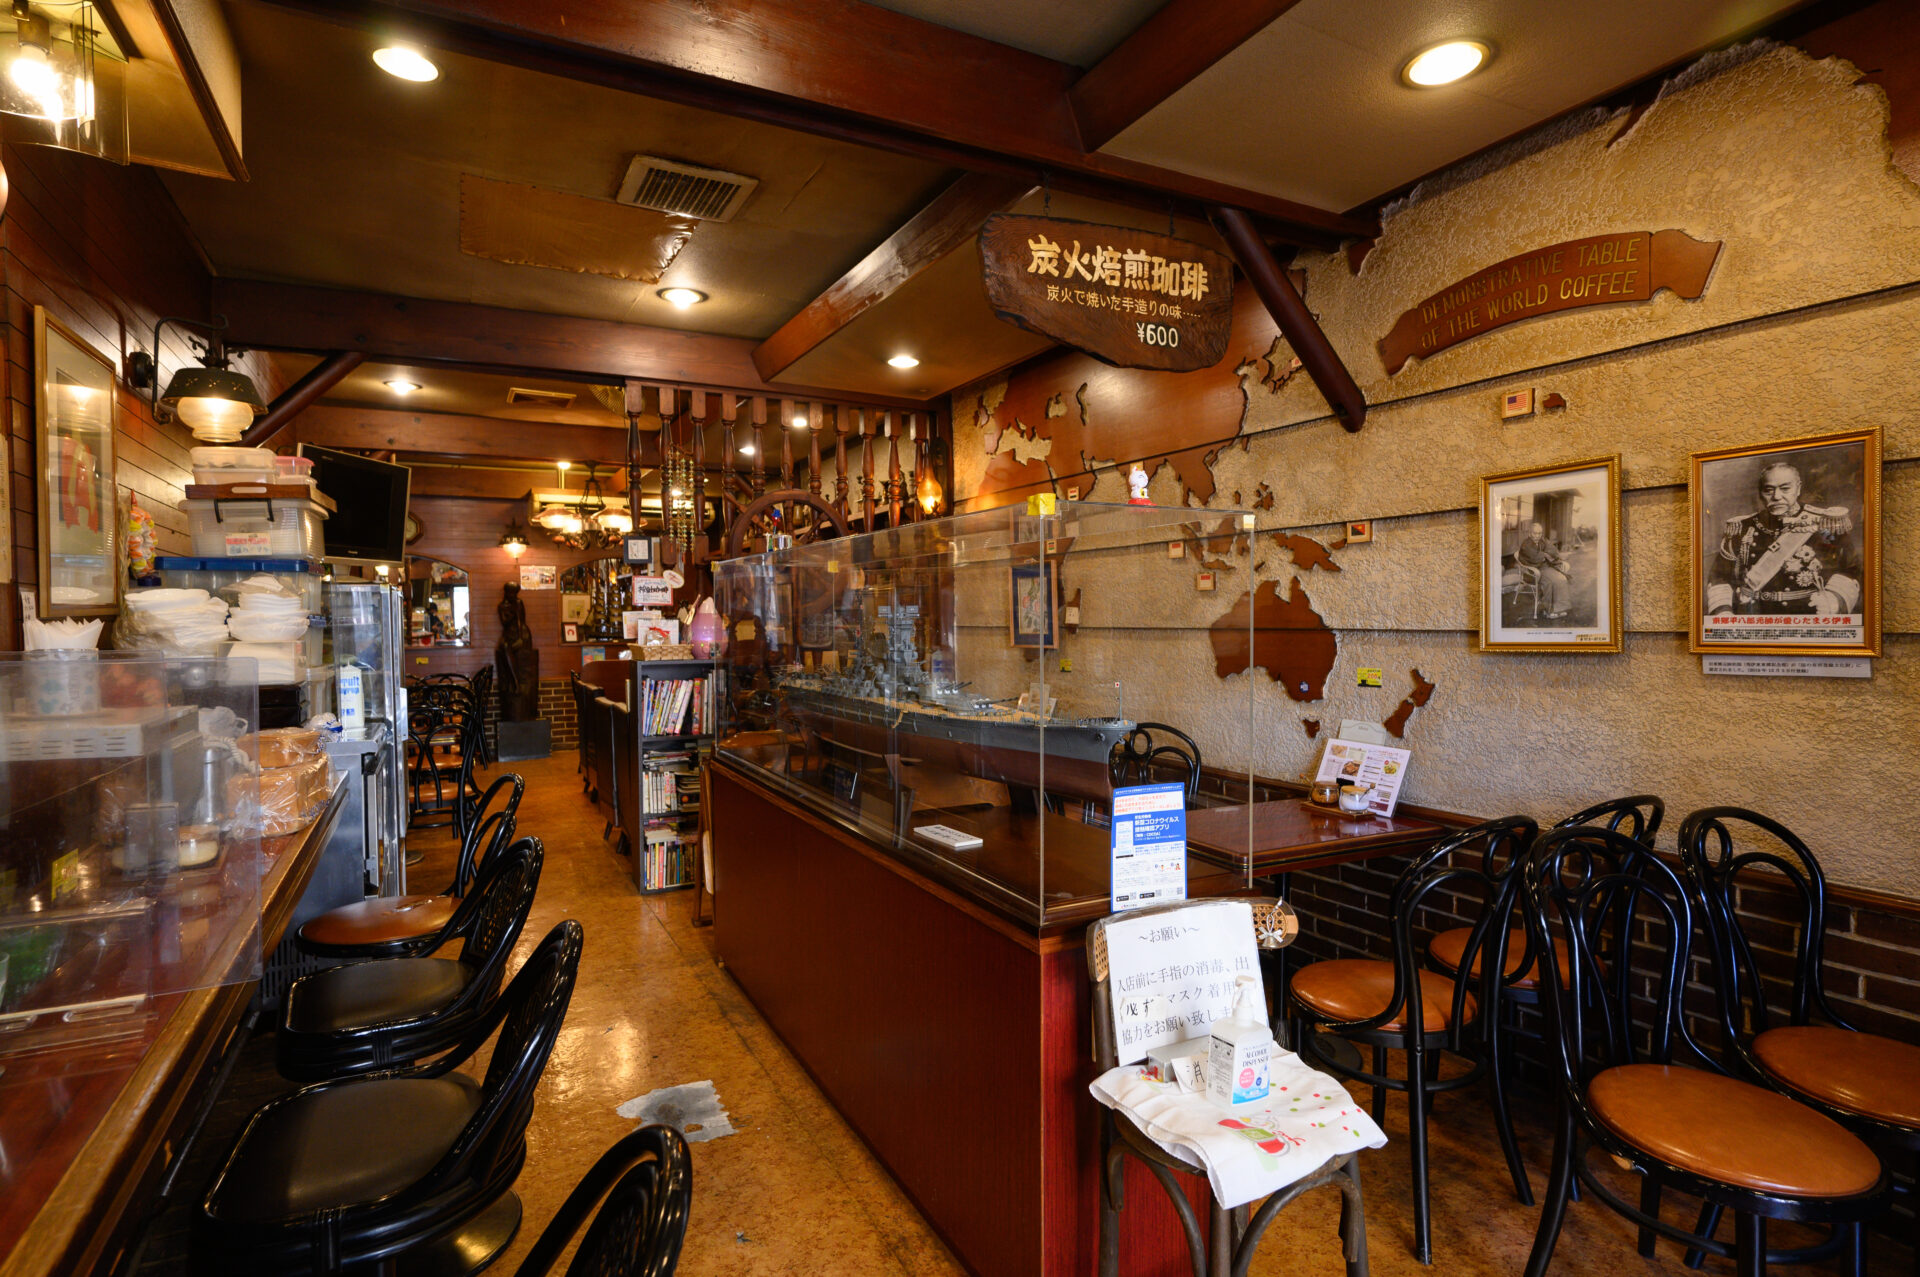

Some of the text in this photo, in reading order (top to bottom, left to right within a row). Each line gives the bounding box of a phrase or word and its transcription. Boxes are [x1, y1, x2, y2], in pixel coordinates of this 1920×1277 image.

[1027, 234, 1209, 301] 炭火焙煎珈琲
[1422, 238, 1641, 324] DEMONSTRATIVE TABLE
[1136, 322, 1179, 347] ¥600
[1421, 270, 1638, 349] OF THE WORLD COFFEE
